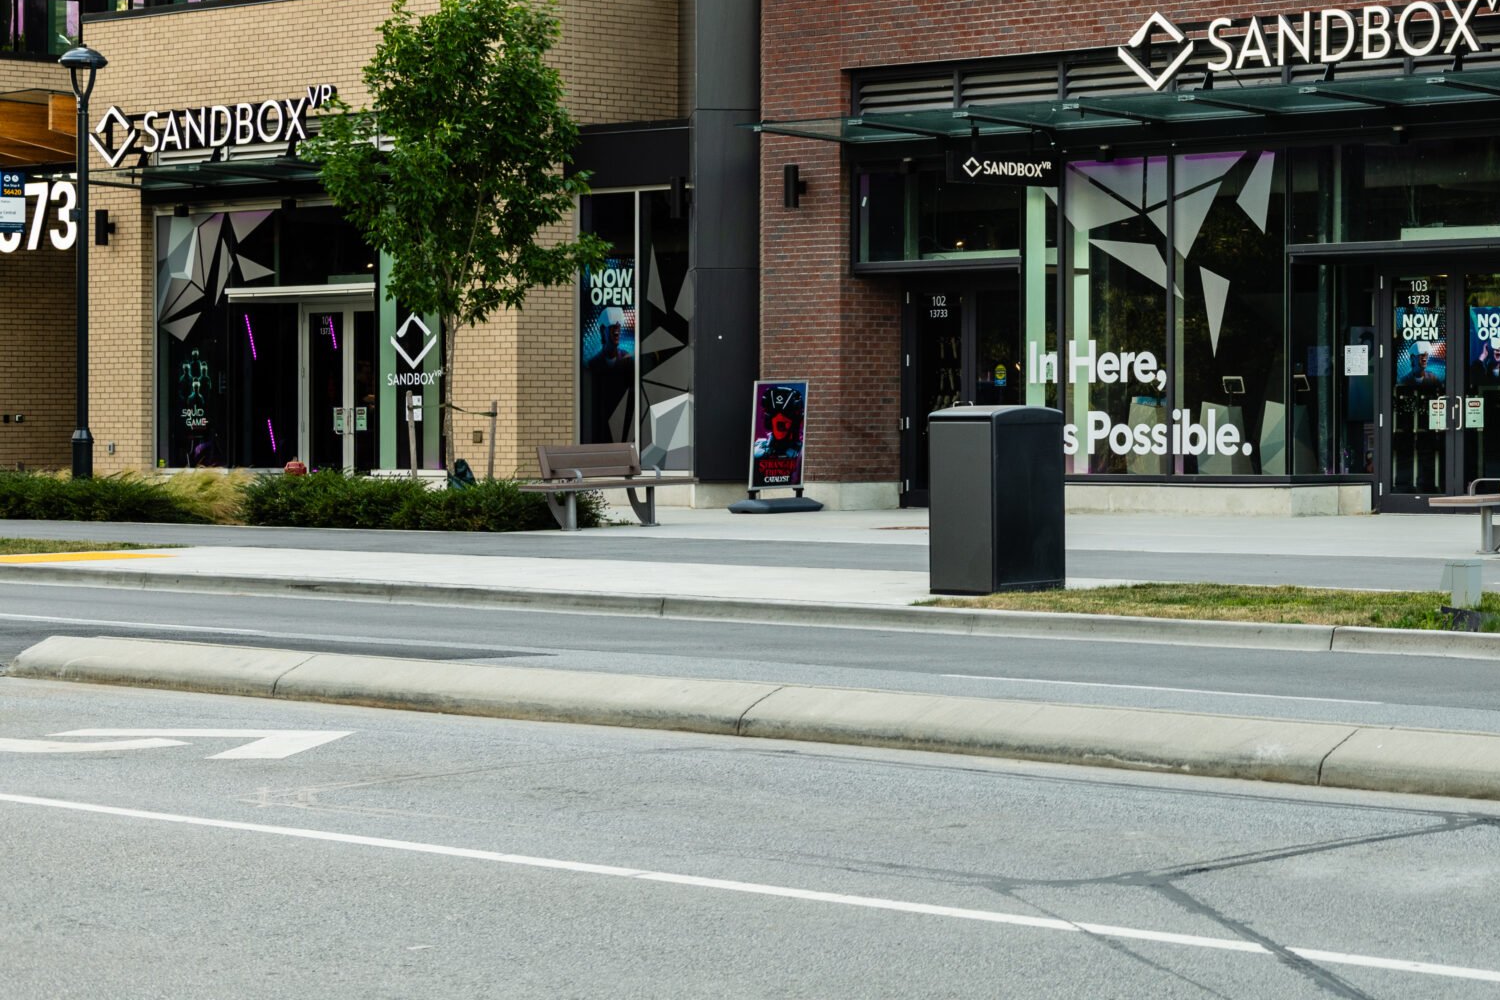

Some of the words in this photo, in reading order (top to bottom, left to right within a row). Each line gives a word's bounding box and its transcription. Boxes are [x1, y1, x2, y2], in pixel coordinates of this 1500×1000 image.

[143, 97, 306, 153] SANDBOX
[983, 160, 1043, 178] SANDBOX
[590, 268, 633, 288] NOW
[1410, 280, 1428, 292] 103
[590, 287, 632, 306] OPEN
[932, 295, 946, 307] 102
[1408, 295, 1430, 304] 13733
[929, 309, 948, 318] 13733
[1402, 313, 1439, 328] NOW
[1402, 327, 1439, 340] OPEN
[1029, 341, 1058, 384] In
[1068, 339, 1167, 391] Here,
[387, 373, 434, 386] SANDBOX
[185, 417, 209, 429] GAME
[1087, 408, 1253, 456] Possible.
